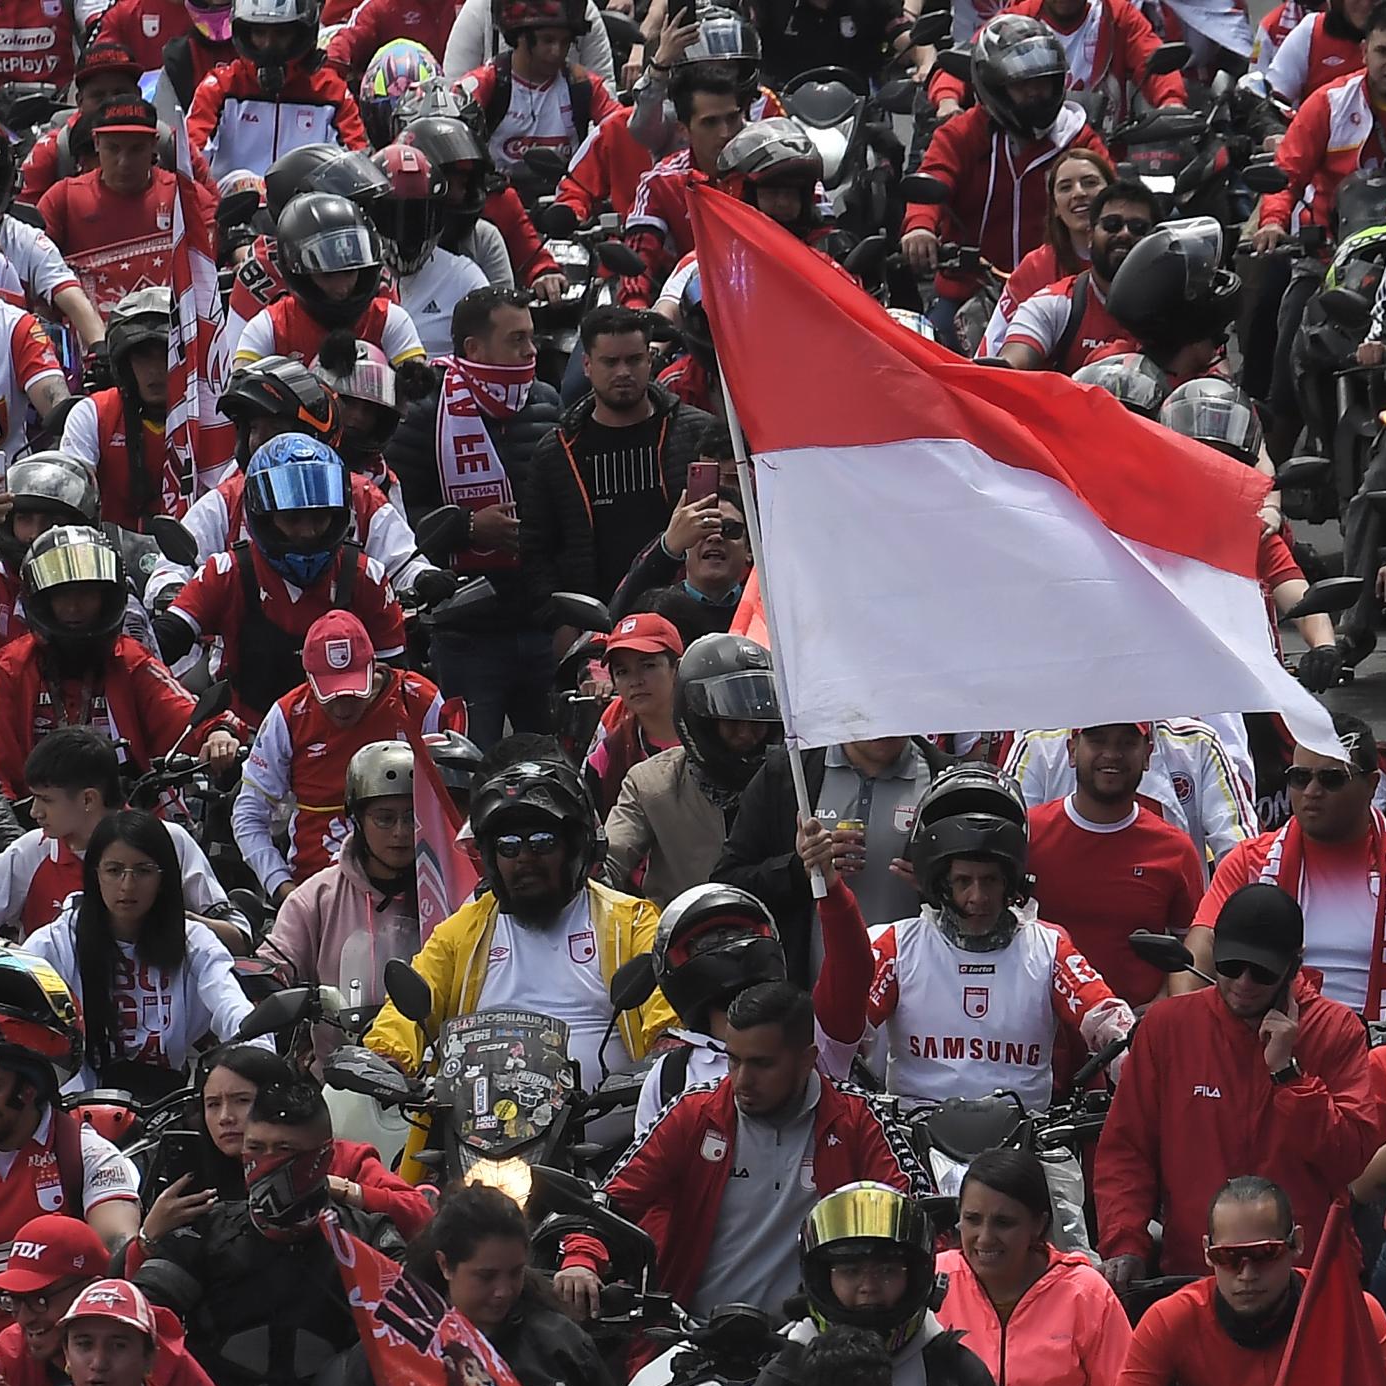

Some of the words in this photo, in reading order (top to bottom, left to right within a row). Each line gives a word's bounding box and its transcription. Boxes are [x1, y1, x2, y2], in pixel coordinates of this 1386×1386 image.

[969, 964, 993, 974] lotto
[910, 1035, 1040, 1067] SAMSUNG
[1194, 1085, 1221, 1098] FILA
[10, 1241, 47, 1260] FOX
